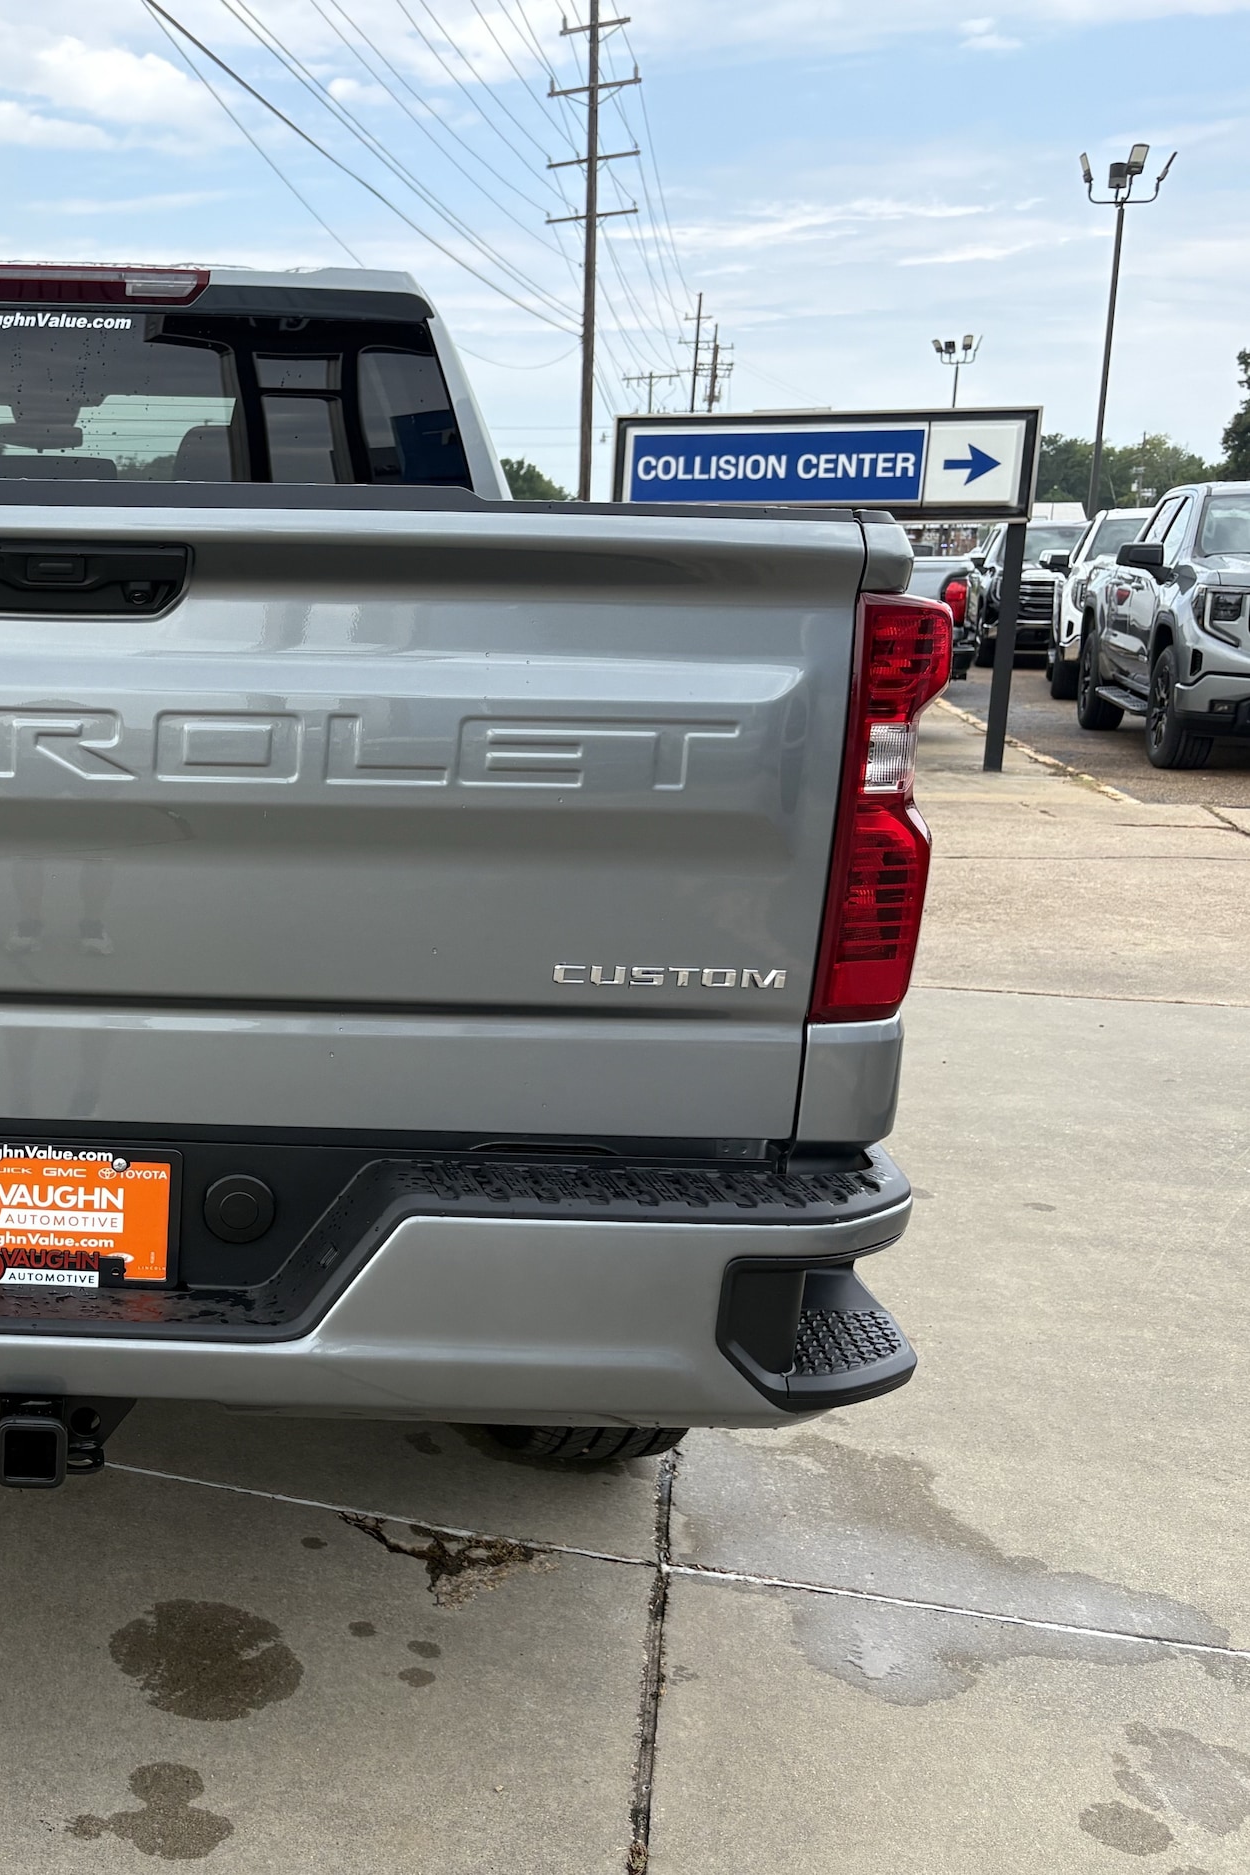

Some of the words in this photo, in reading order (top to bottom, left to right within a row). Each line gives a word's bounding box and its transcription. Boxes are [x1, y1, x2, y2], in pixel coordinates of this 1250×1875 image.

[637, 454, 788, 481] COLLISION
[796, 453, 917, 480] CENTER
[552, 962, 788, 989] CUSTOM
[42, 1167, 87, 1178] GMC
[119, 1168, 168, 1180] TOYOTA
[5, 1213, 119, 1229] AUTOMOTIVE
[0, 1247, 100, 1271] VAUGHN
[8, 1271, 96, 1285] AUTOMOTIVE
